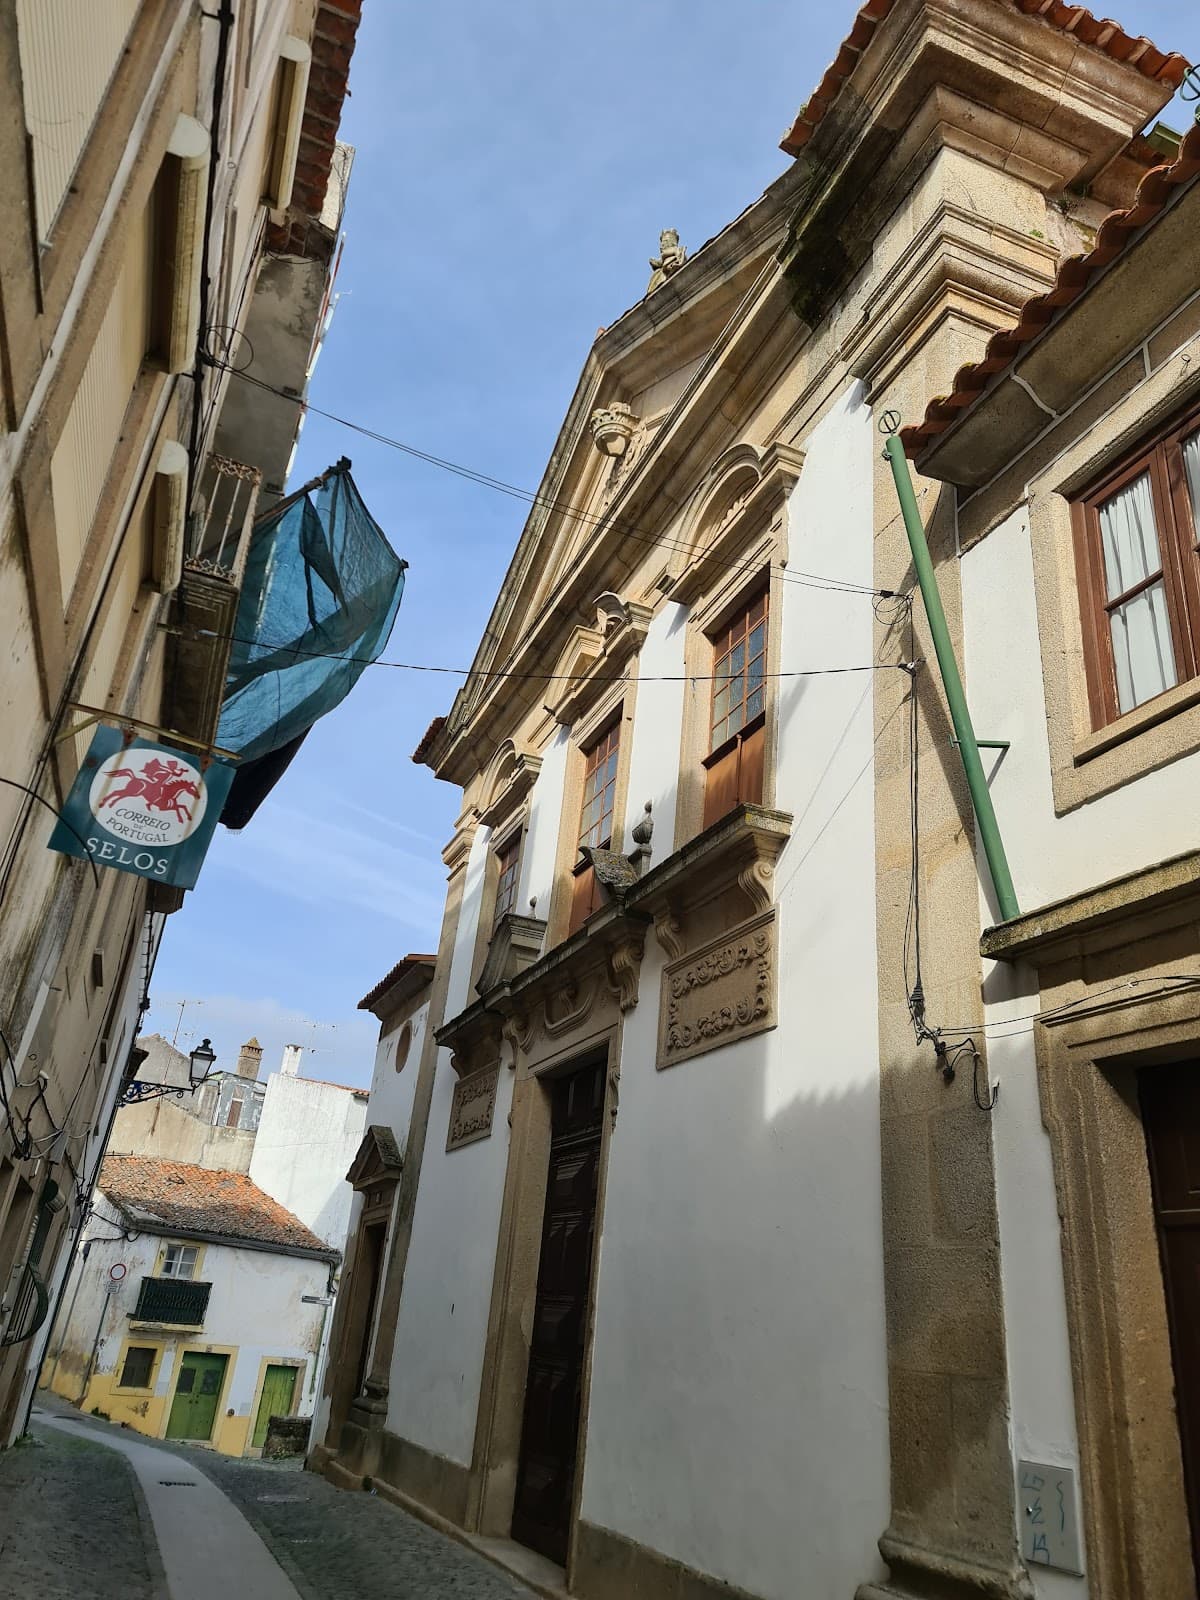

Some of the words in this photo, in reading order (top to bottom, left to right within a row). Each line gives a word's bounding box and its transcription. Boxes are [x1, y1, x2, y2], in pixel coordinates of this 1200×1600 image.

[106, 817, 168, 842] PORTUGAL
[115, 808, 170, 830] CORREIO
[83, 838, 168, 875] SELOS
